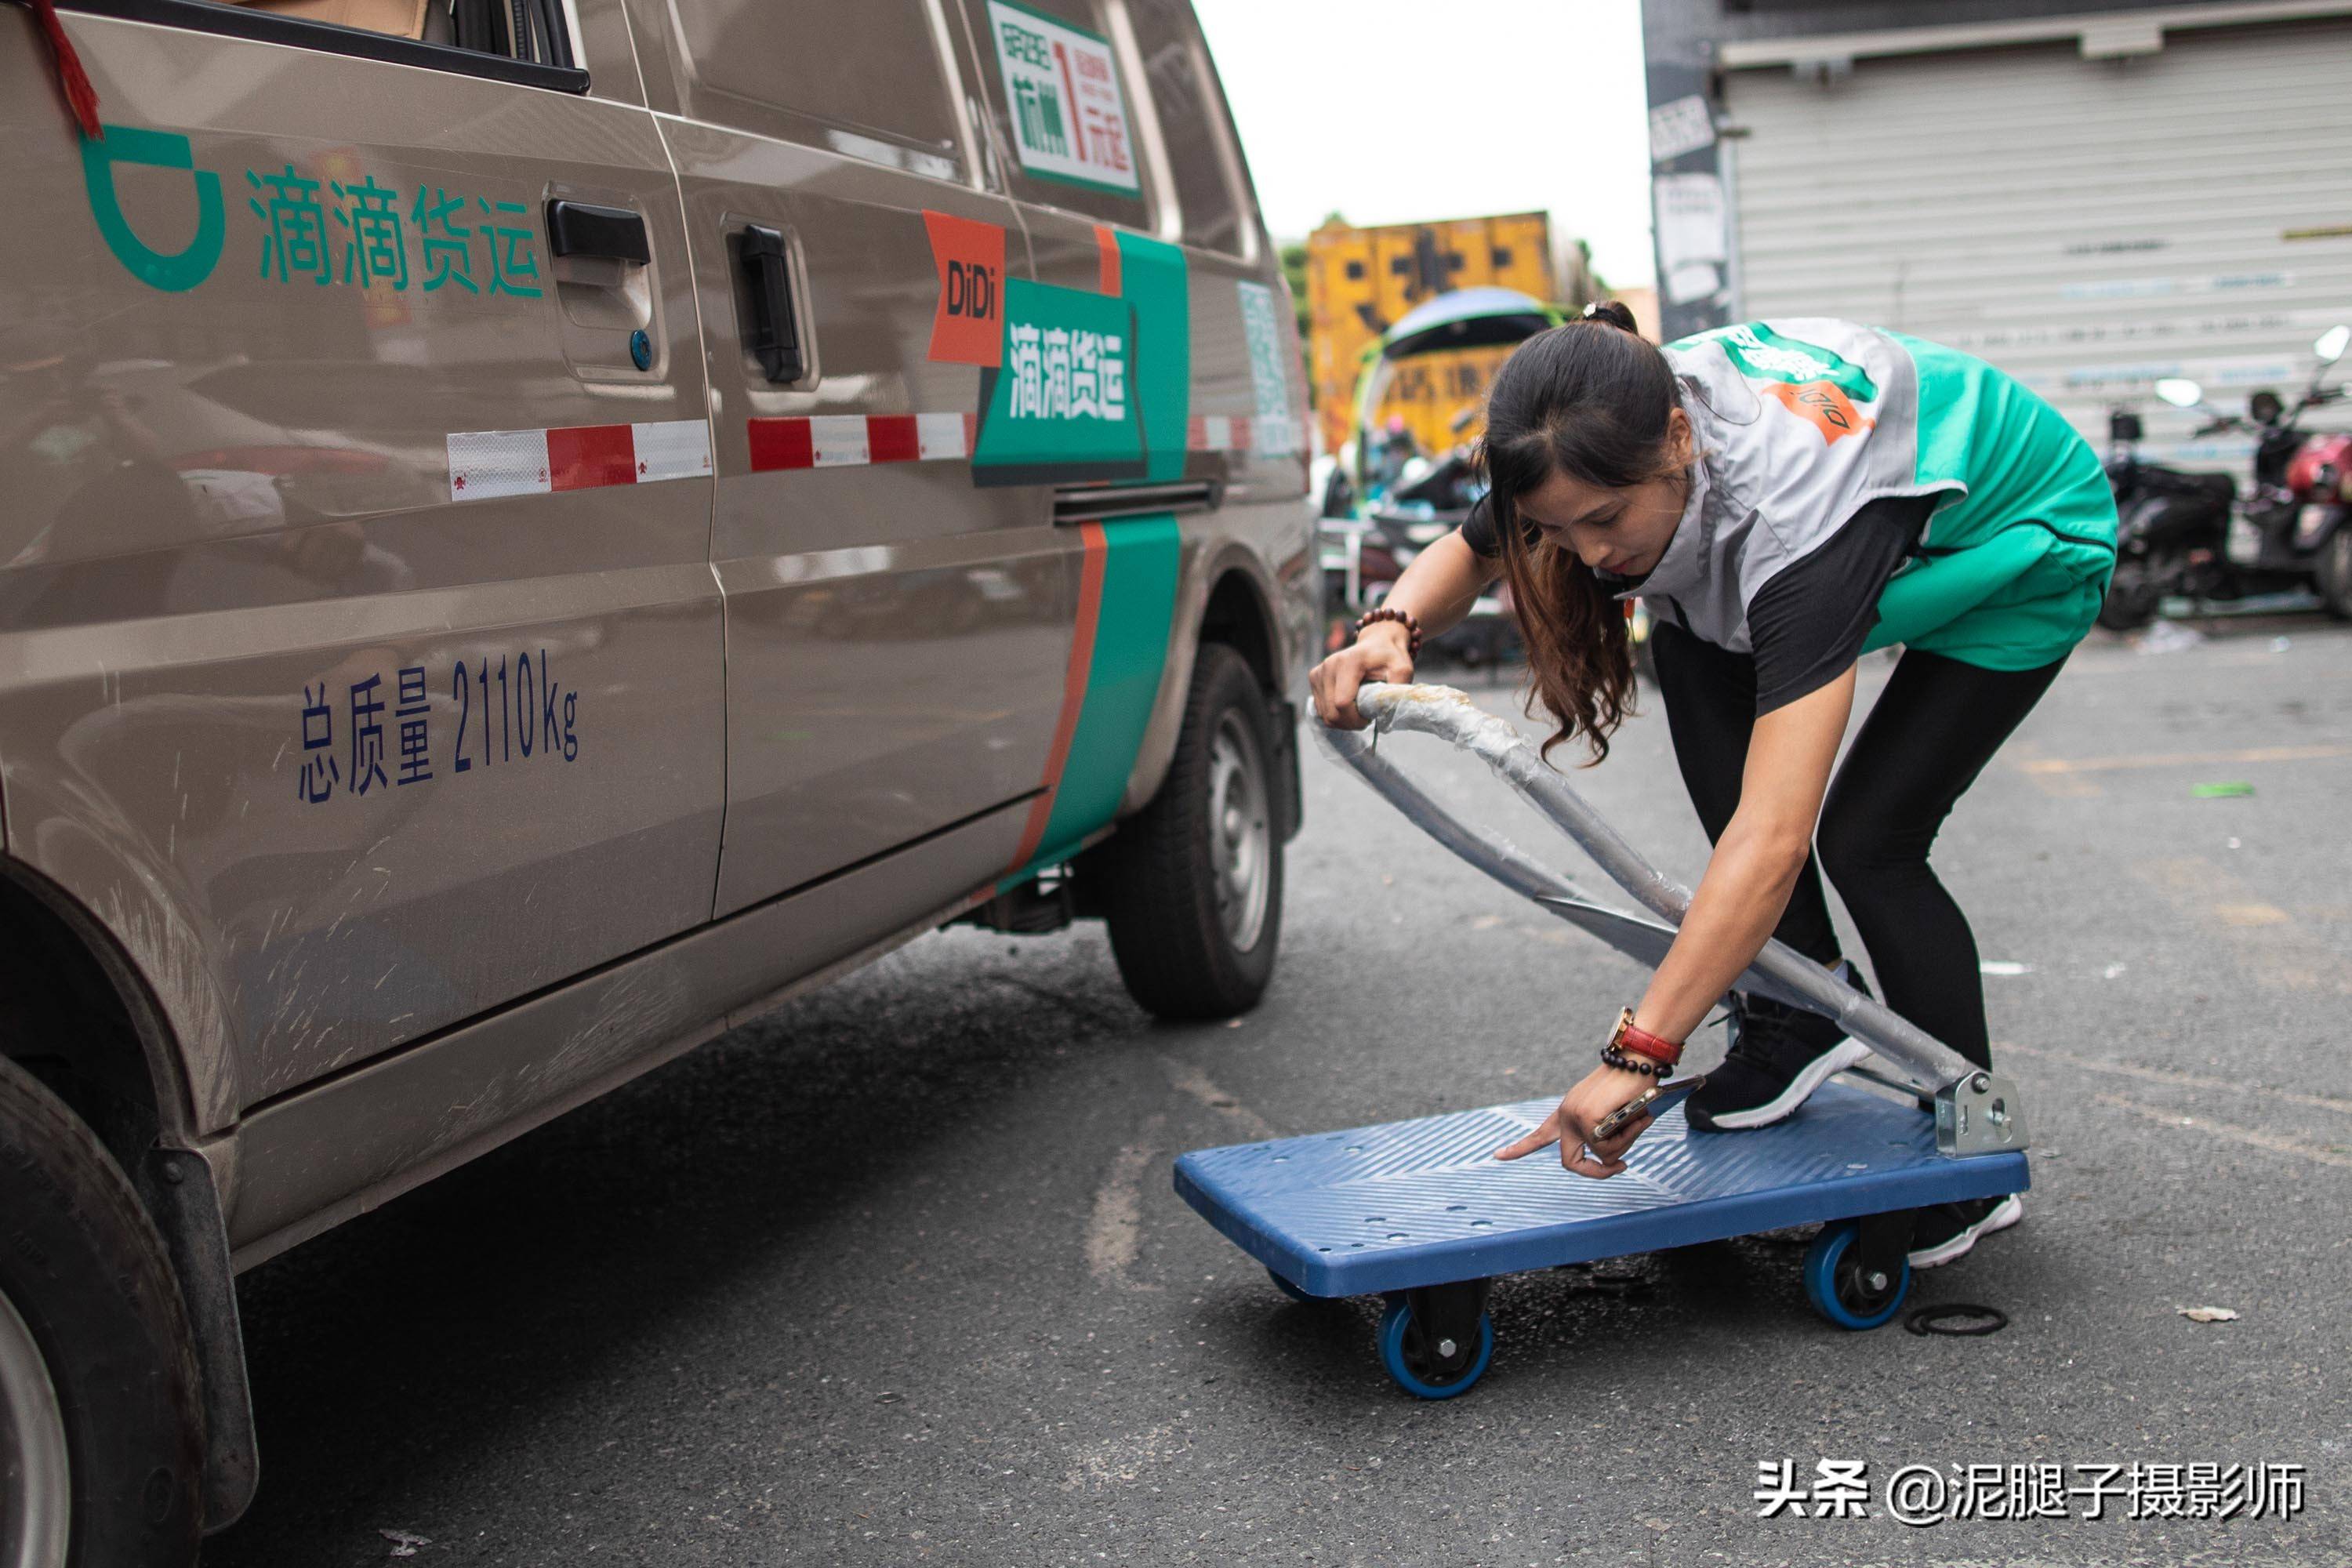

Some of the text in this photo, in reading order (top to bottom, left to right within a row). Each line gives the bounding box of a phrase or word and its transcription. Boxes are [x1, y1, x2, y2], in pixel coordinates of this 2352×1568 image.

[246, 164, 543, 299] 滴滴货运
[947, 260, 995, 321] DiDi
[1010, 321, 1126, 422] 滴滴货运
[299, 648, 579, 804] 总质量 2110kg
